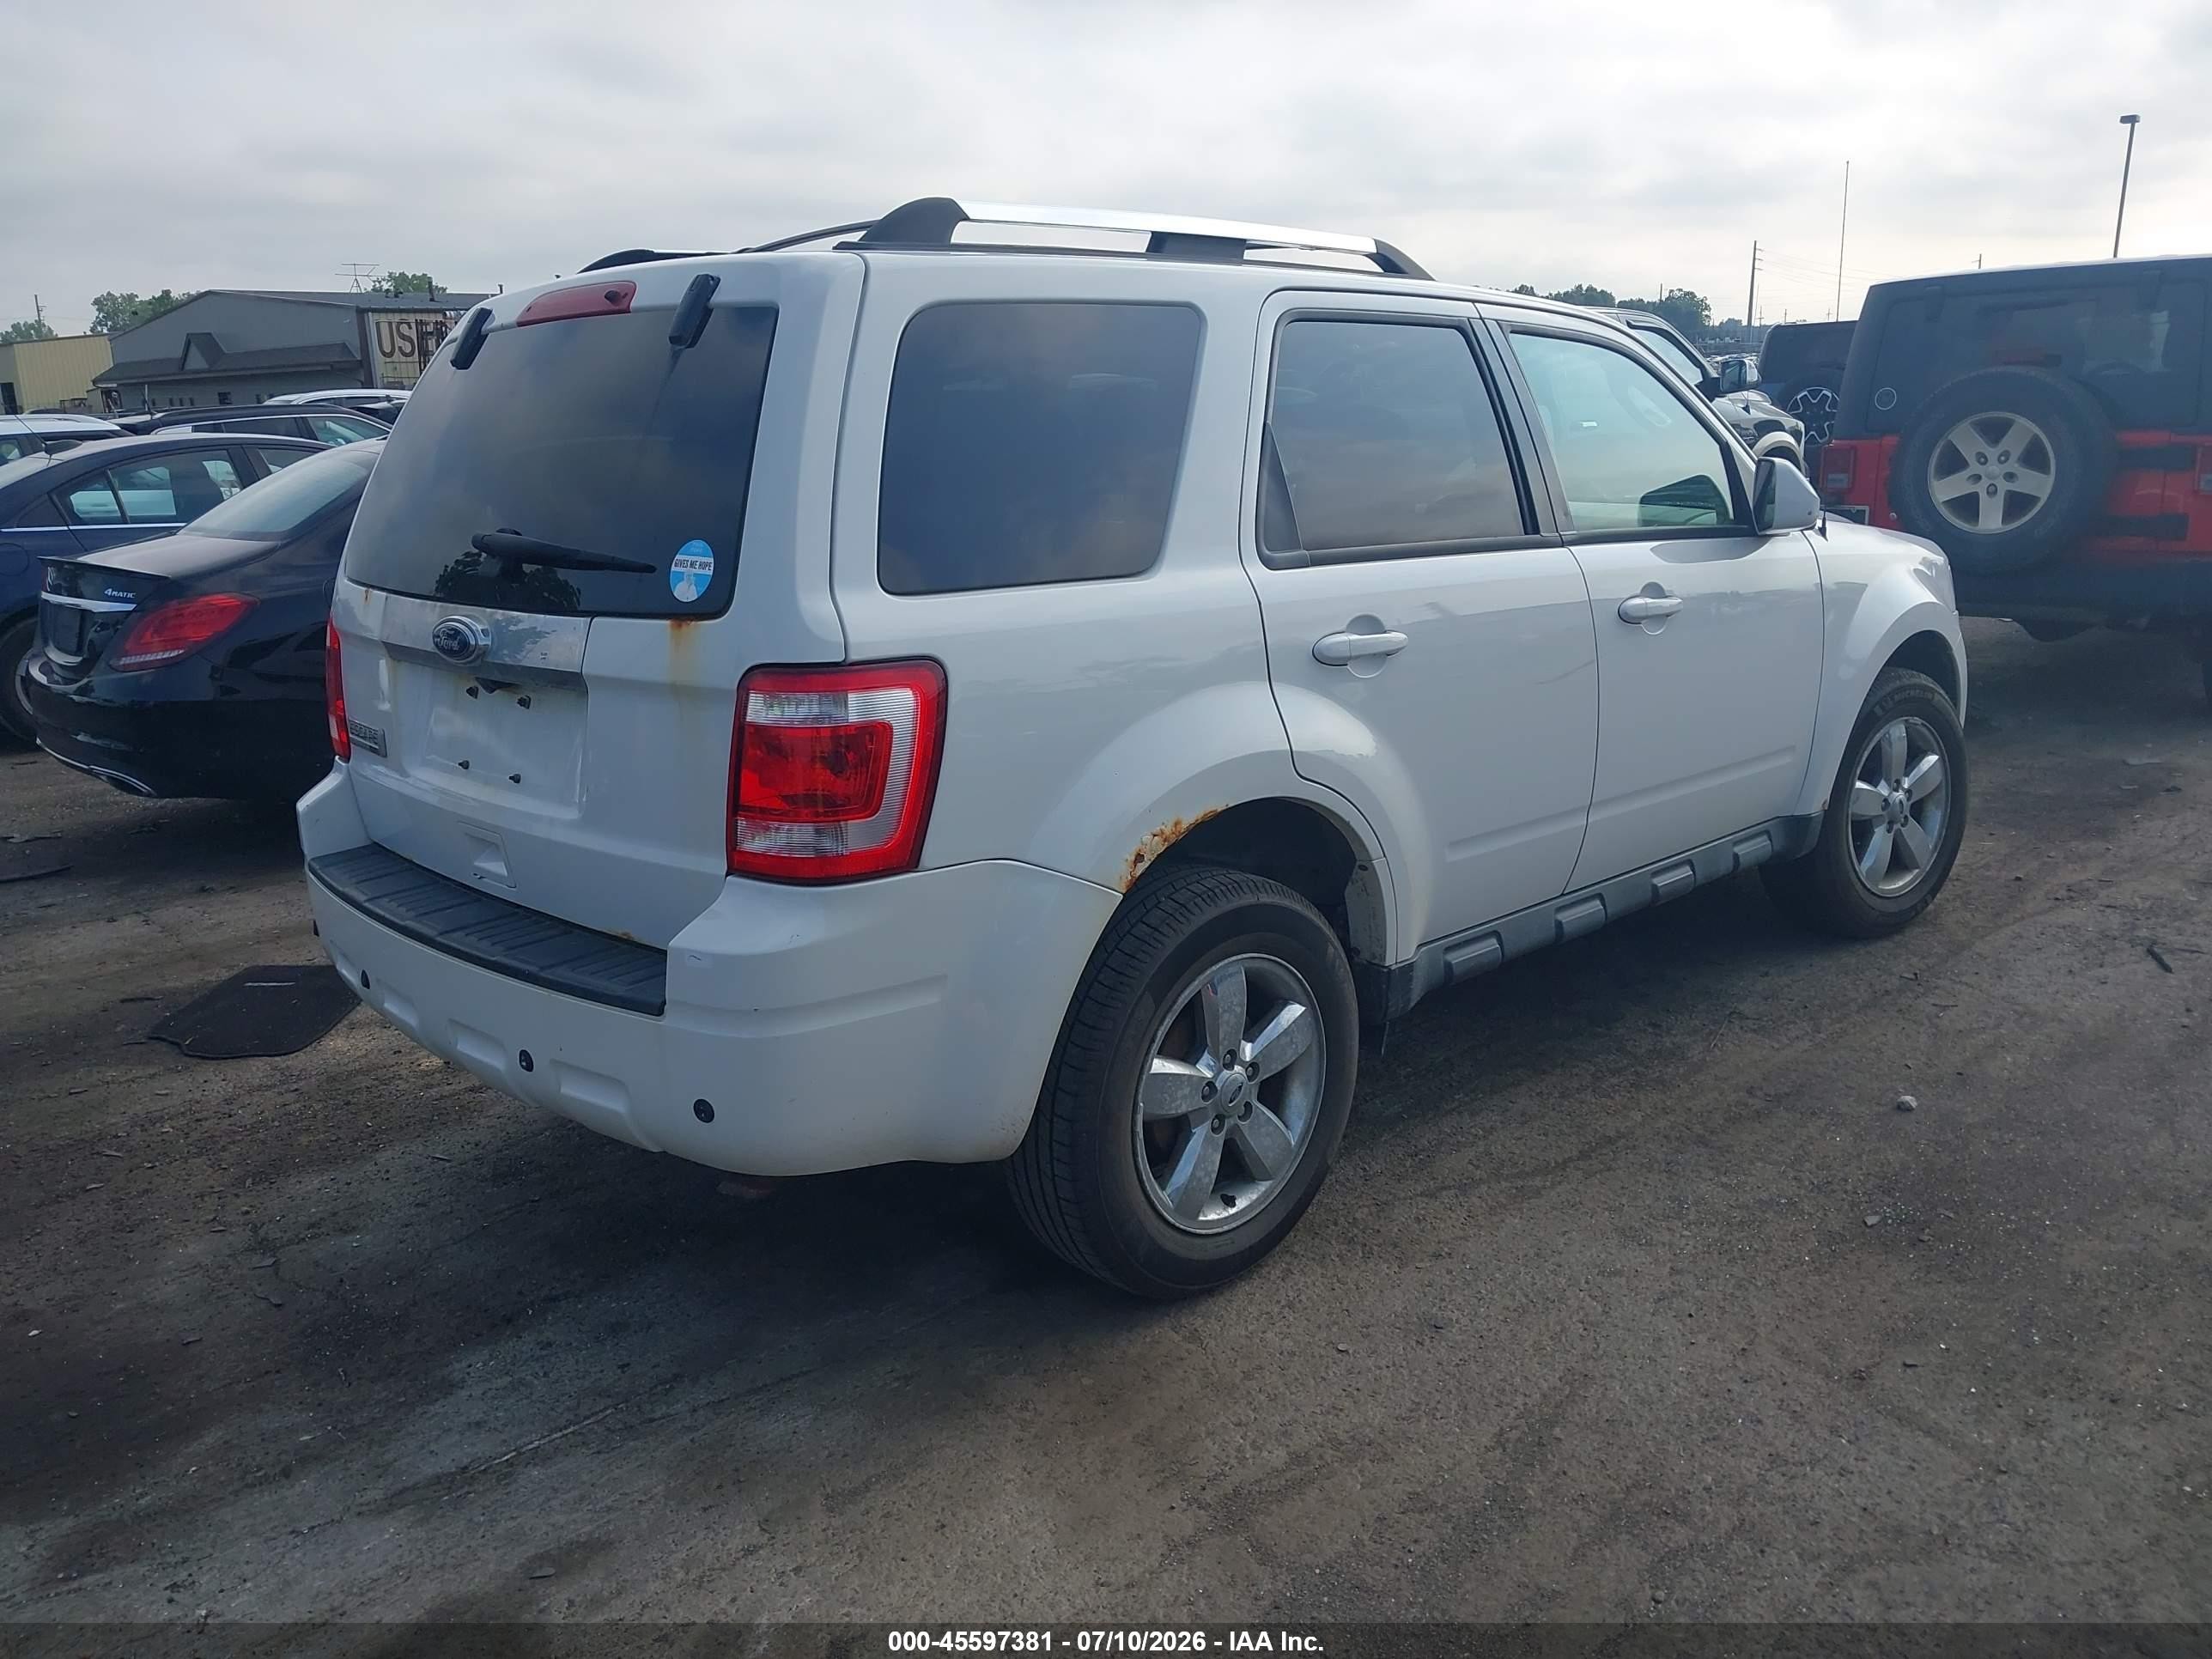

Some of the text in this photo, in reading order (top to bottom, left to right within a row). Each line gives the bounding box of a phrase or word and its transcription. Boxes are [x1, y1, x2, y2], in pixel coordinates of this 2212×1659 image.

[673, 558, 713, 571] GIVES ME HOPE
[104, 587, 137, 599] 4MATIC
[434, 628, 460, 652] Ford
